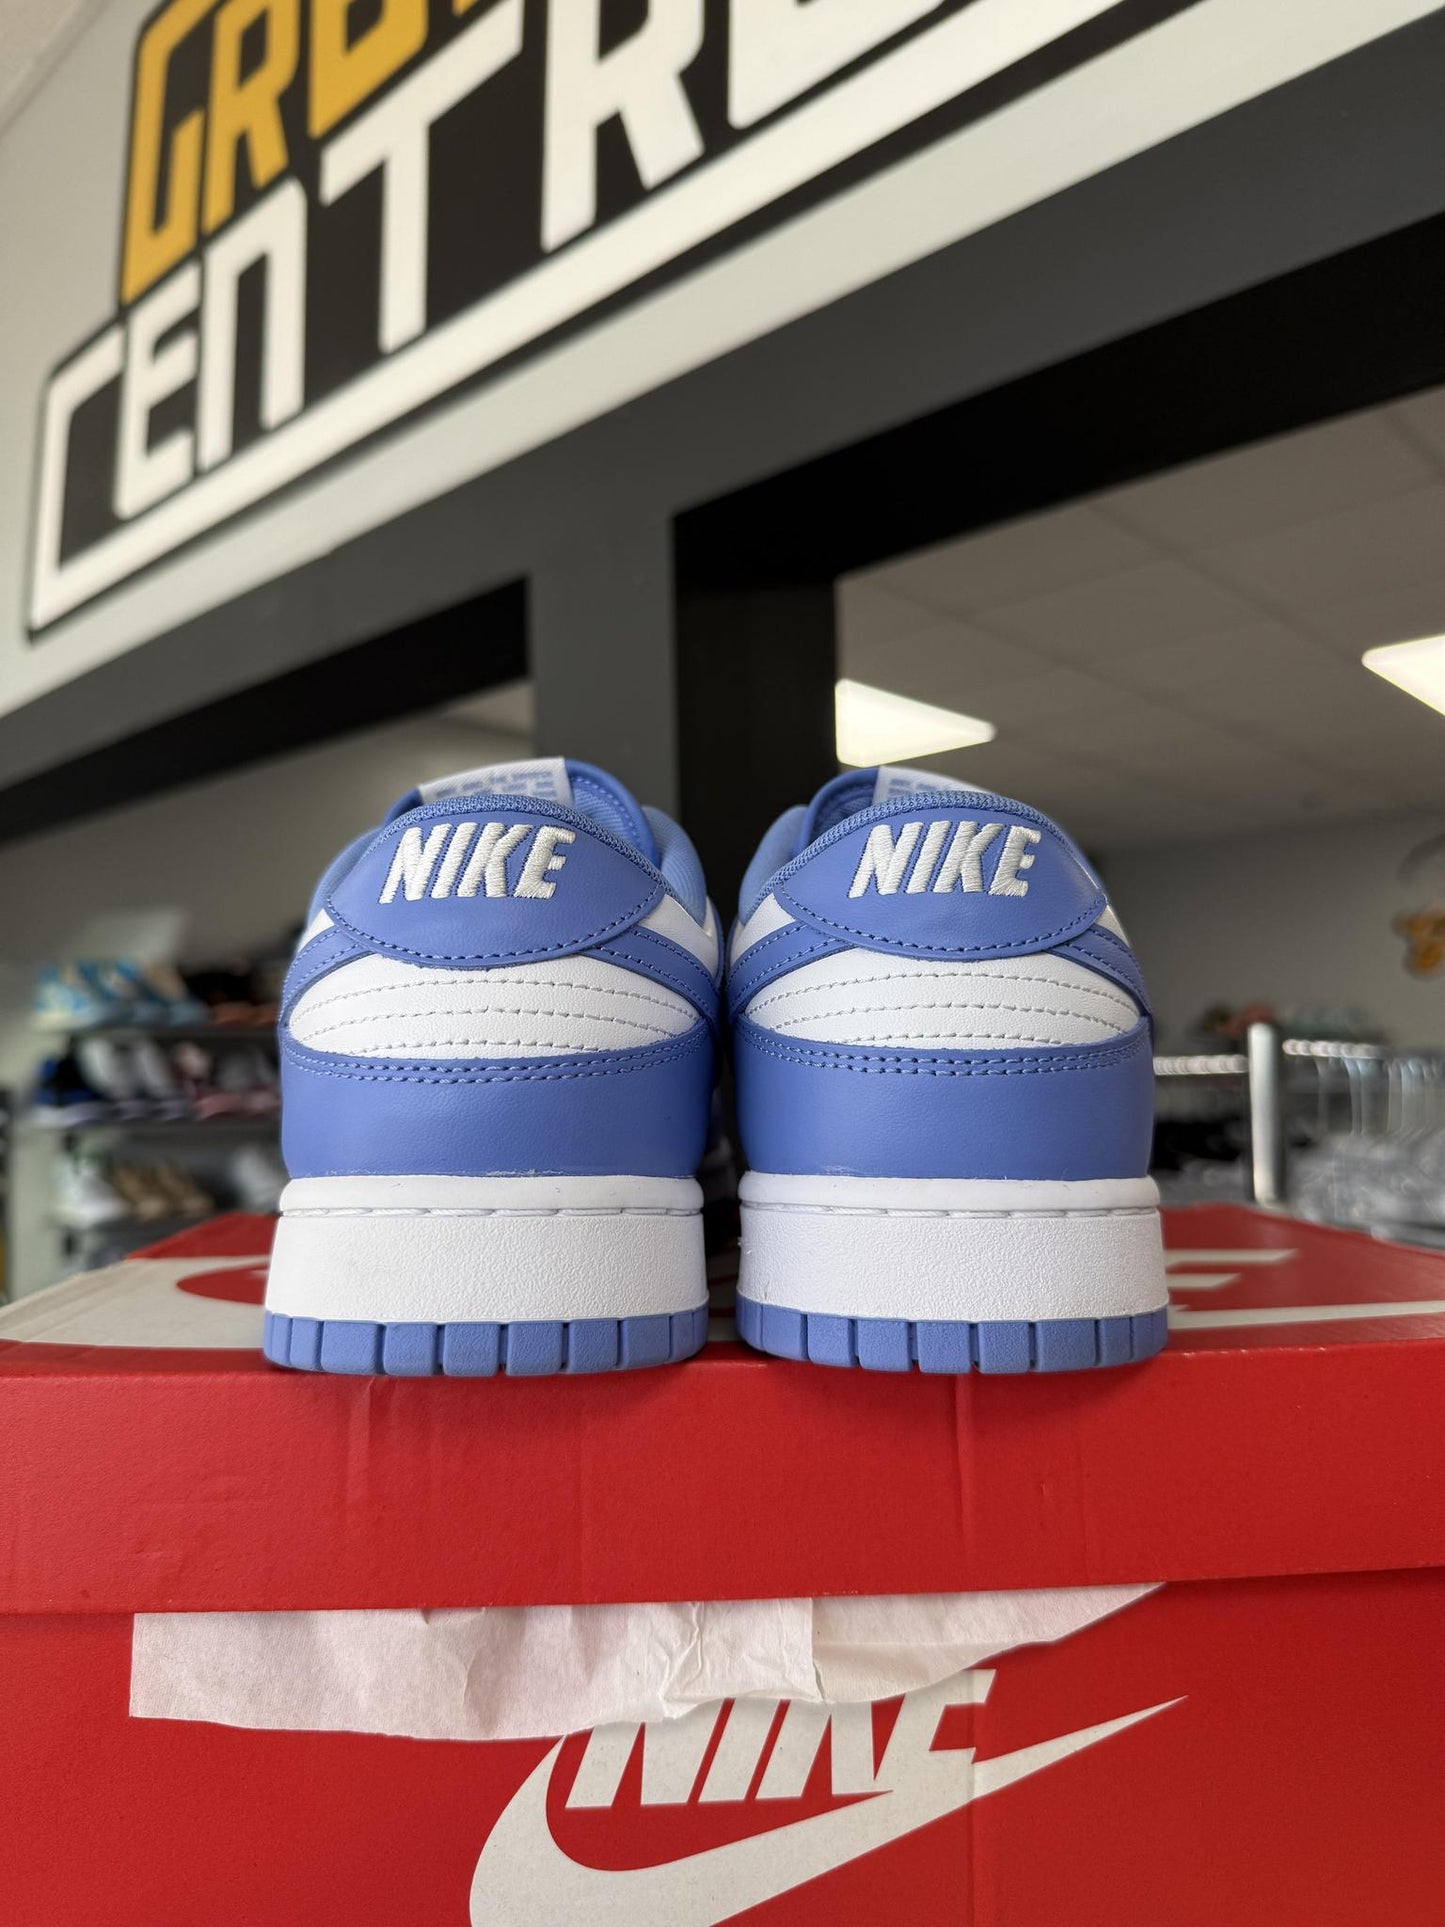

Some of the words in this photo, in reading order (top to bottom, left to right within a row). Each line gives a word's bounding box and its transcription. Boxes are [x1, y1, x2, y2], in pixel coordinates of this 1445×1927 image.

[378, 821, 576, 904] NIKE
[848, 820, 1042, 899] NIKE
[564, 1667, 998, 1810] NIKE
